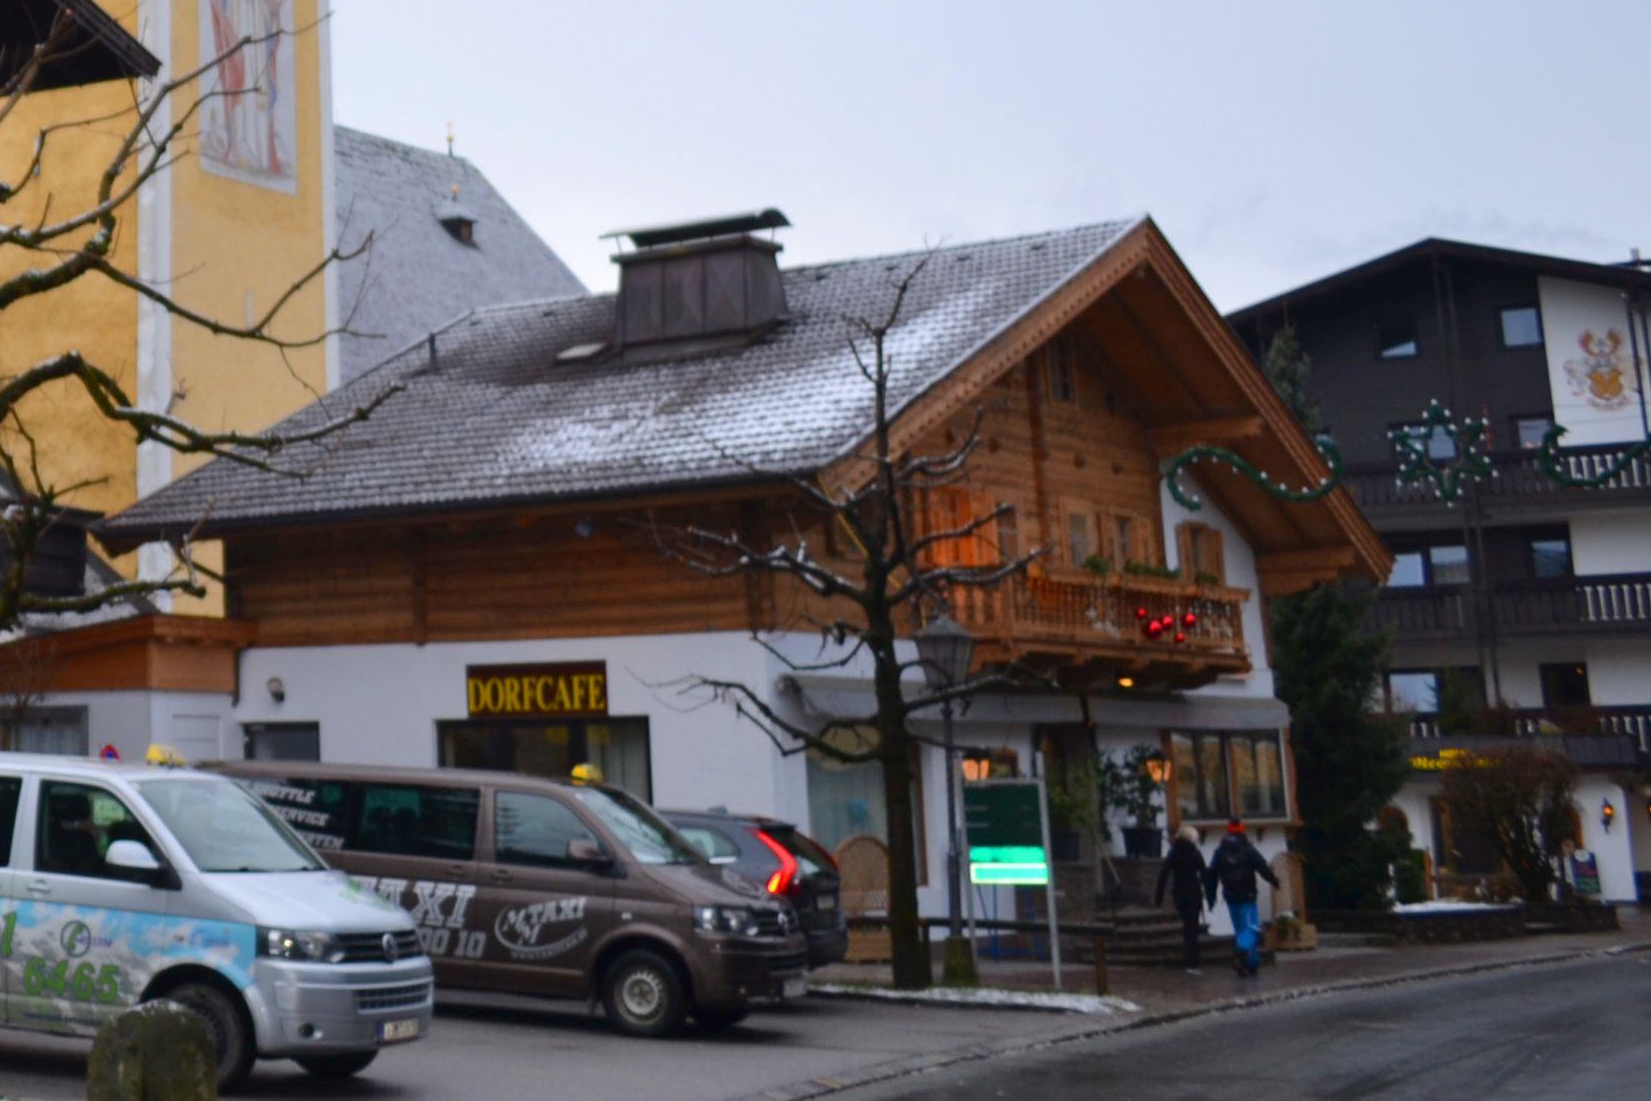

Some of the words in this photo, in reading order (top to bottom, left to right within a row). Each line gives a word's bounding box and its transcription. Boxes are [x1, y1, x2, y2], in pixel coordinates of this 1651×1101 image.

[468, 674, 605, 712] DORFCAFE
[454, 930, 486, 958] 10
[23, 955, 120, 1002] 6465
